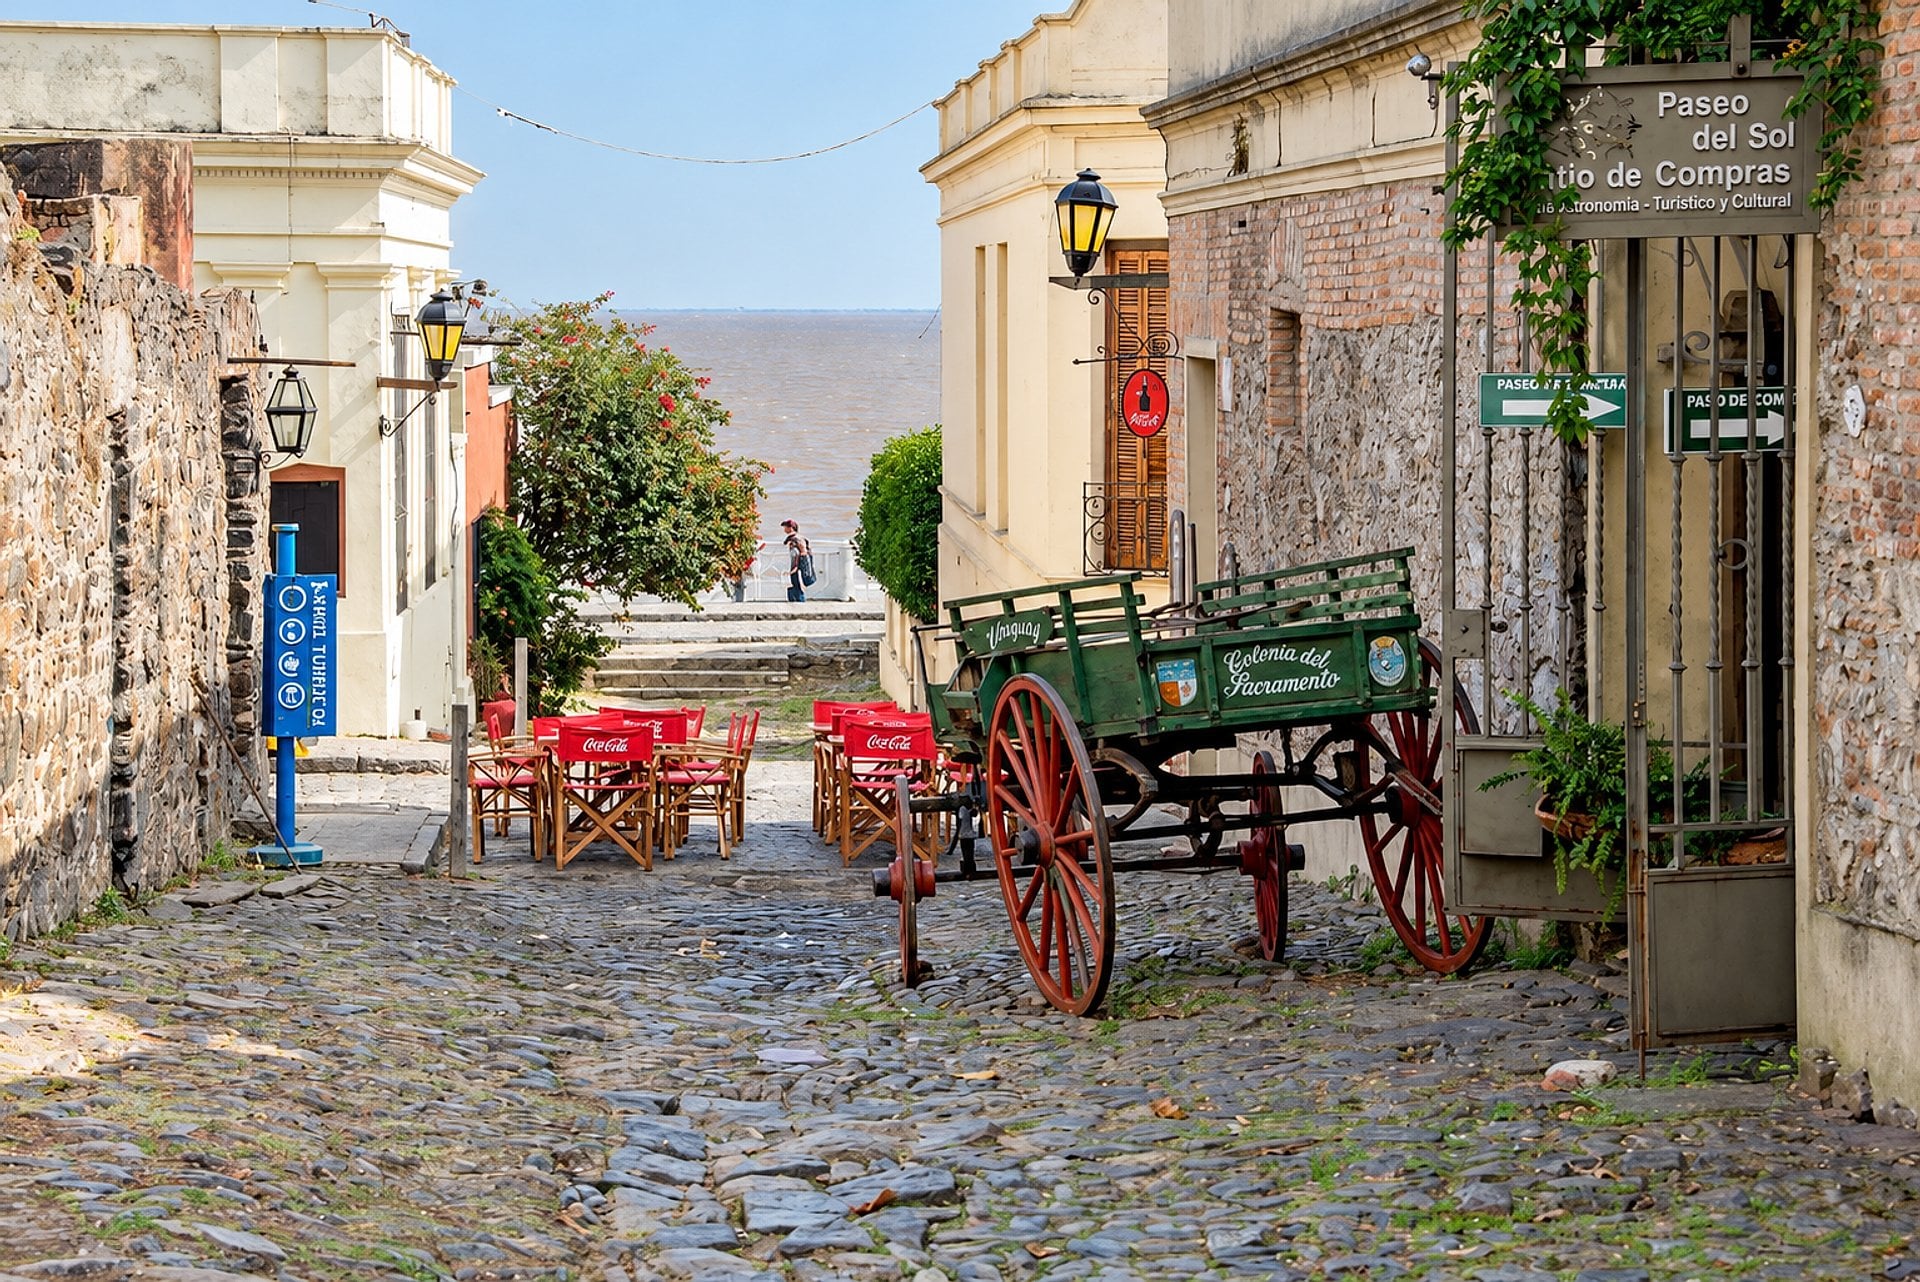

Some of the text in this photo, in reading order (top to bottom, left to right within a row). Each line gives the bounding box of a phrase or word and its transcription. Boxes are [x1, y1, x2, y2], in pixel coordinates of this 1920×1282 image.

[1658, 91, 1749, 117] Paseo
[1692, 121, 1795, 151] del Sol
[1607, 161, 1642, 188] de
[1656, 160, 1791, 191] Compras
[1719, 198, 1729, 213] y
[1732, 192, 1792, 209] Cultural
[1497, 378, 1539, 390] PASEO
[1728, 393, 1748, 407] DE
[1300, 647, 1332, 669] del
[1223, 668, 1341, 699] Sacramento
